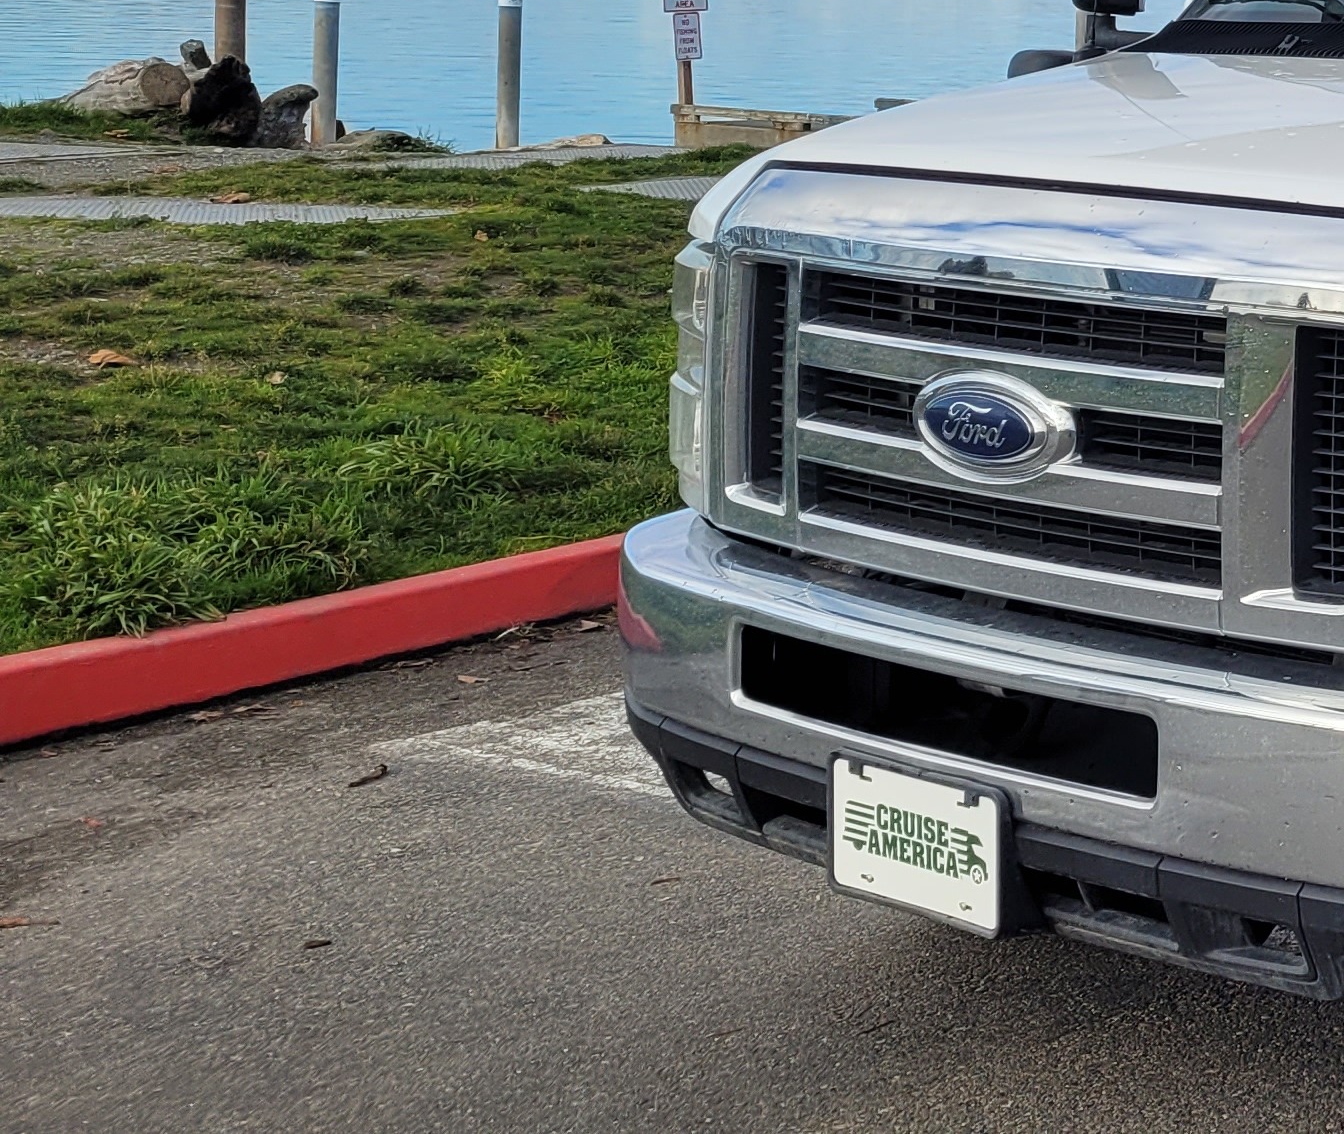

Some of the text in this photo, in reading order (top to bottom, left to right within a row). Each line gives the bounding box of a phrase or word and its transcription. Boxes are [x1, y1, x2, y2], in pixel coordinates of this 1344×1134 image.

[675, 0, 695, 8] AREA
[941, 401, 1009, 449] Ford
[876, 803, 950, 848] CRUISE
[867, 828, 960, 880] AMERICA
